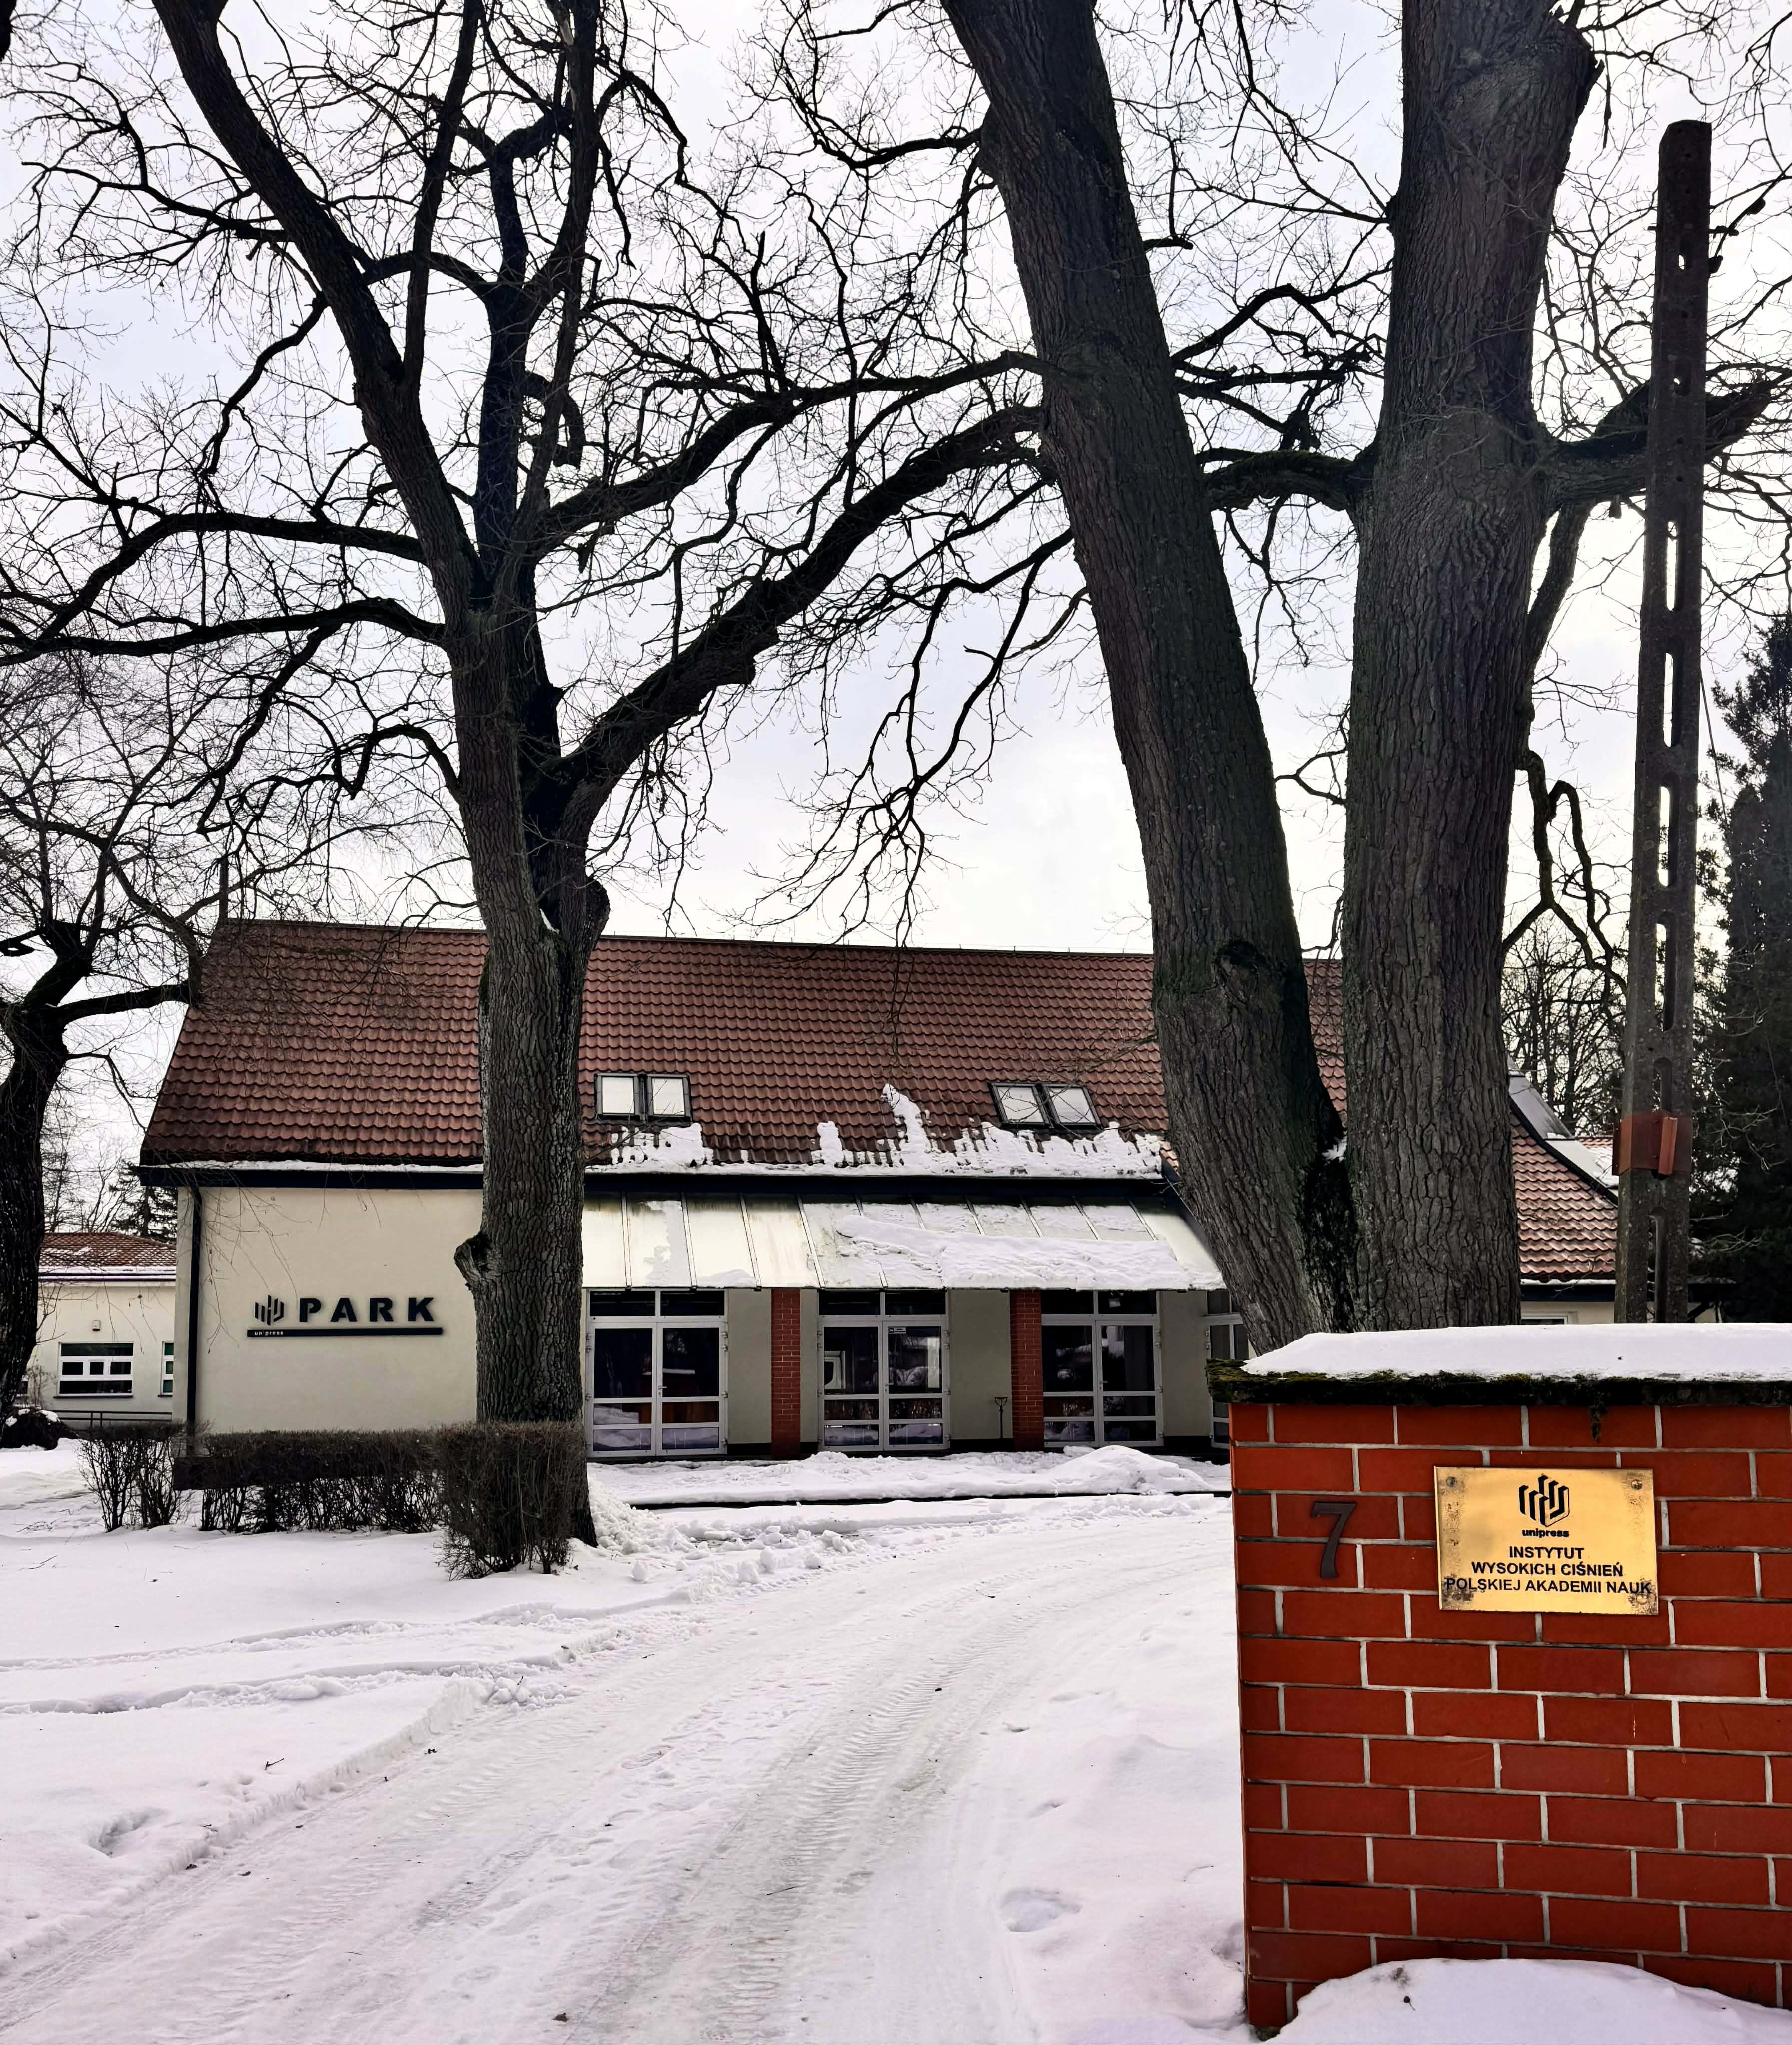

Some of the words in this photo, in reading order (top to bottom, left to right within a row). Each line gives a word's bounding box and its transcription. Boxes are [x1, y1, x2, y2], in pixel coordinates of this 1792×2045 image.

[299, 1297, 434, 1322] PARK
[1310, 1501, 1357, 1578] 7
[1522, 1528, 1570, 1538] unipress
[1509, 1546, 1585, 1559] INSTYTUT
[1471, 1561, 1555, 1575] WYSOKICH
[1561, 1561, 1623, 1577] CIŚNIEŃ
[1446, 1577, 1520, 1590] POLSKIEJ
[1525, 1580, 1601, 1593] AKADEMII
[1606, 1582, 1652, 1594] NAUK
